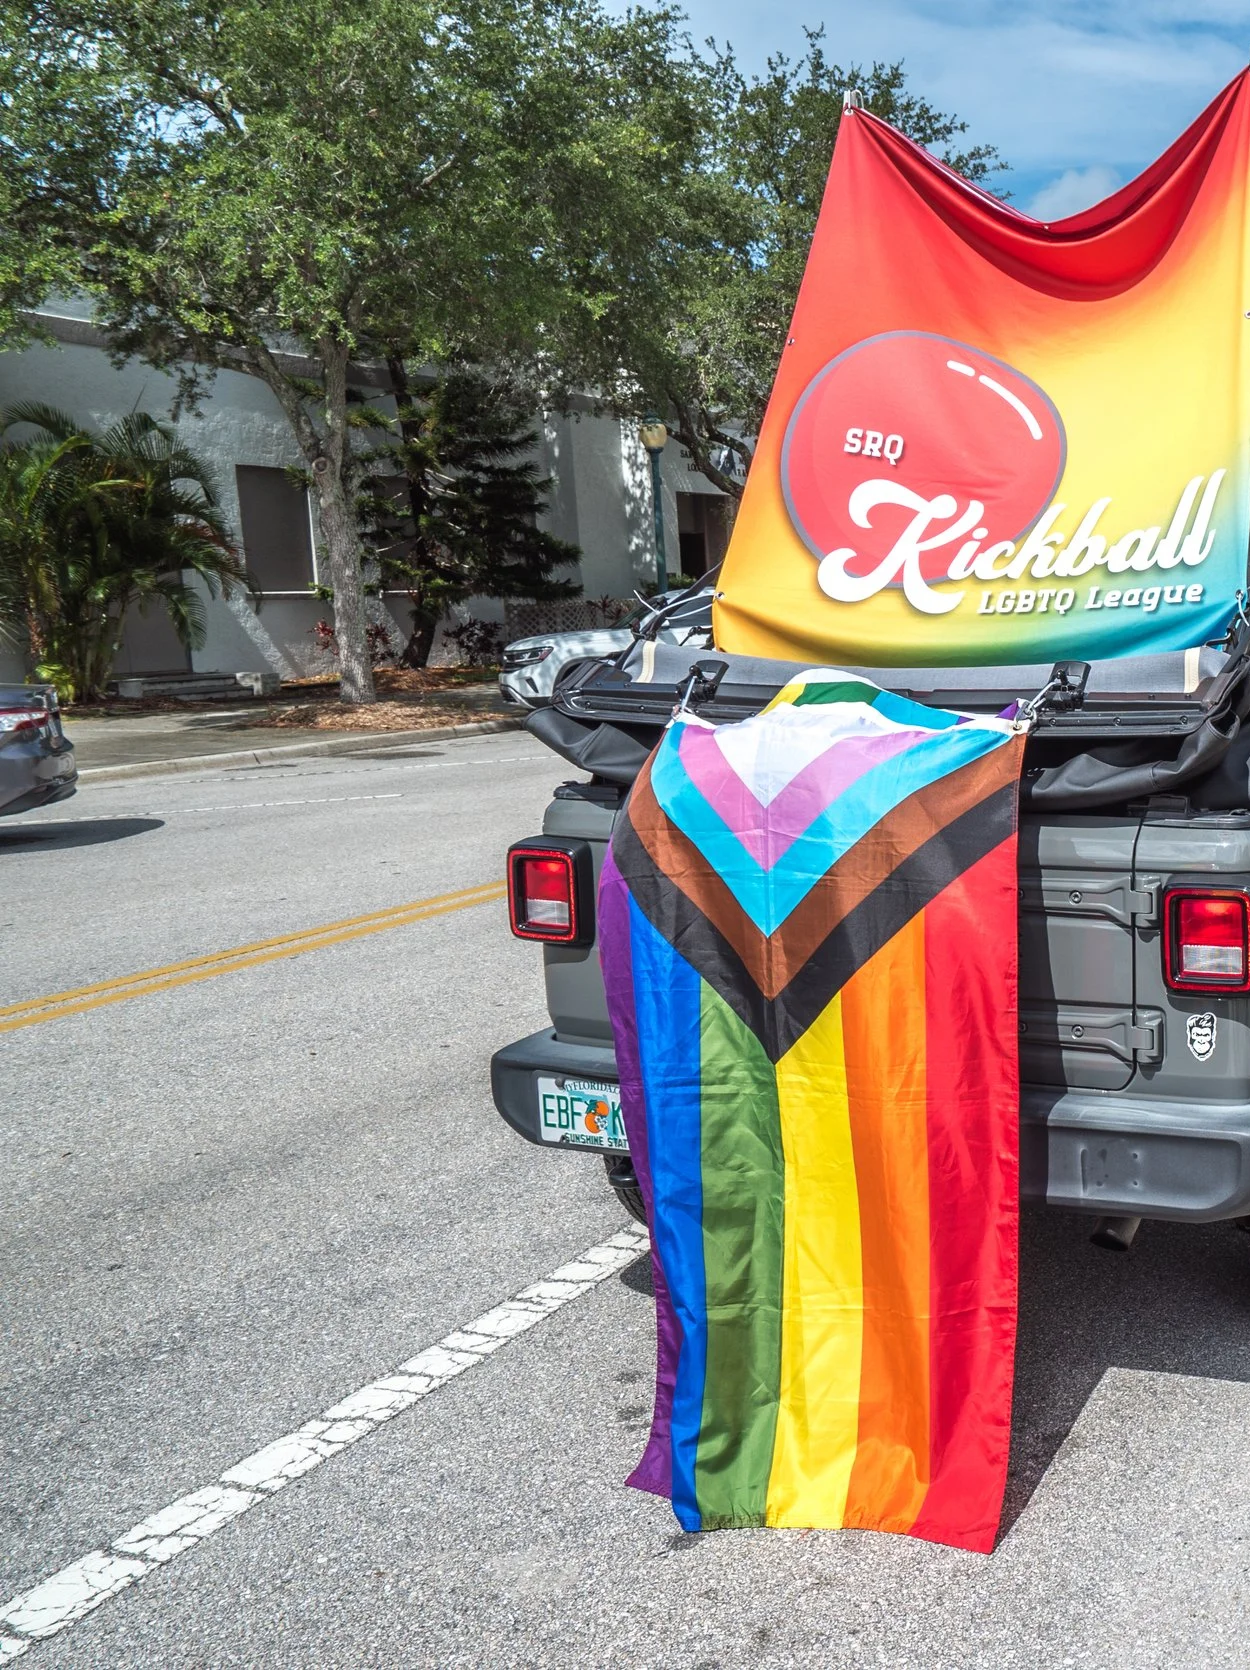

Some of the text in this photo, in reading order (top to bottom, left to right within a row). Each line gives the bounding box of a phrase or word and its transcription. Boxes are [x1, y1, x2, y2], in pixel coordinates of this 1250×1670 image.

[843, 427, 906, 465] SRQ
[817, 468, 1228, 614] Kickball
[976, 581, 1204, 615] LGBTQ League
[542, 1093, 583, 1130] EBF
[565, 1132, 604, 1146] SUNSHINE
